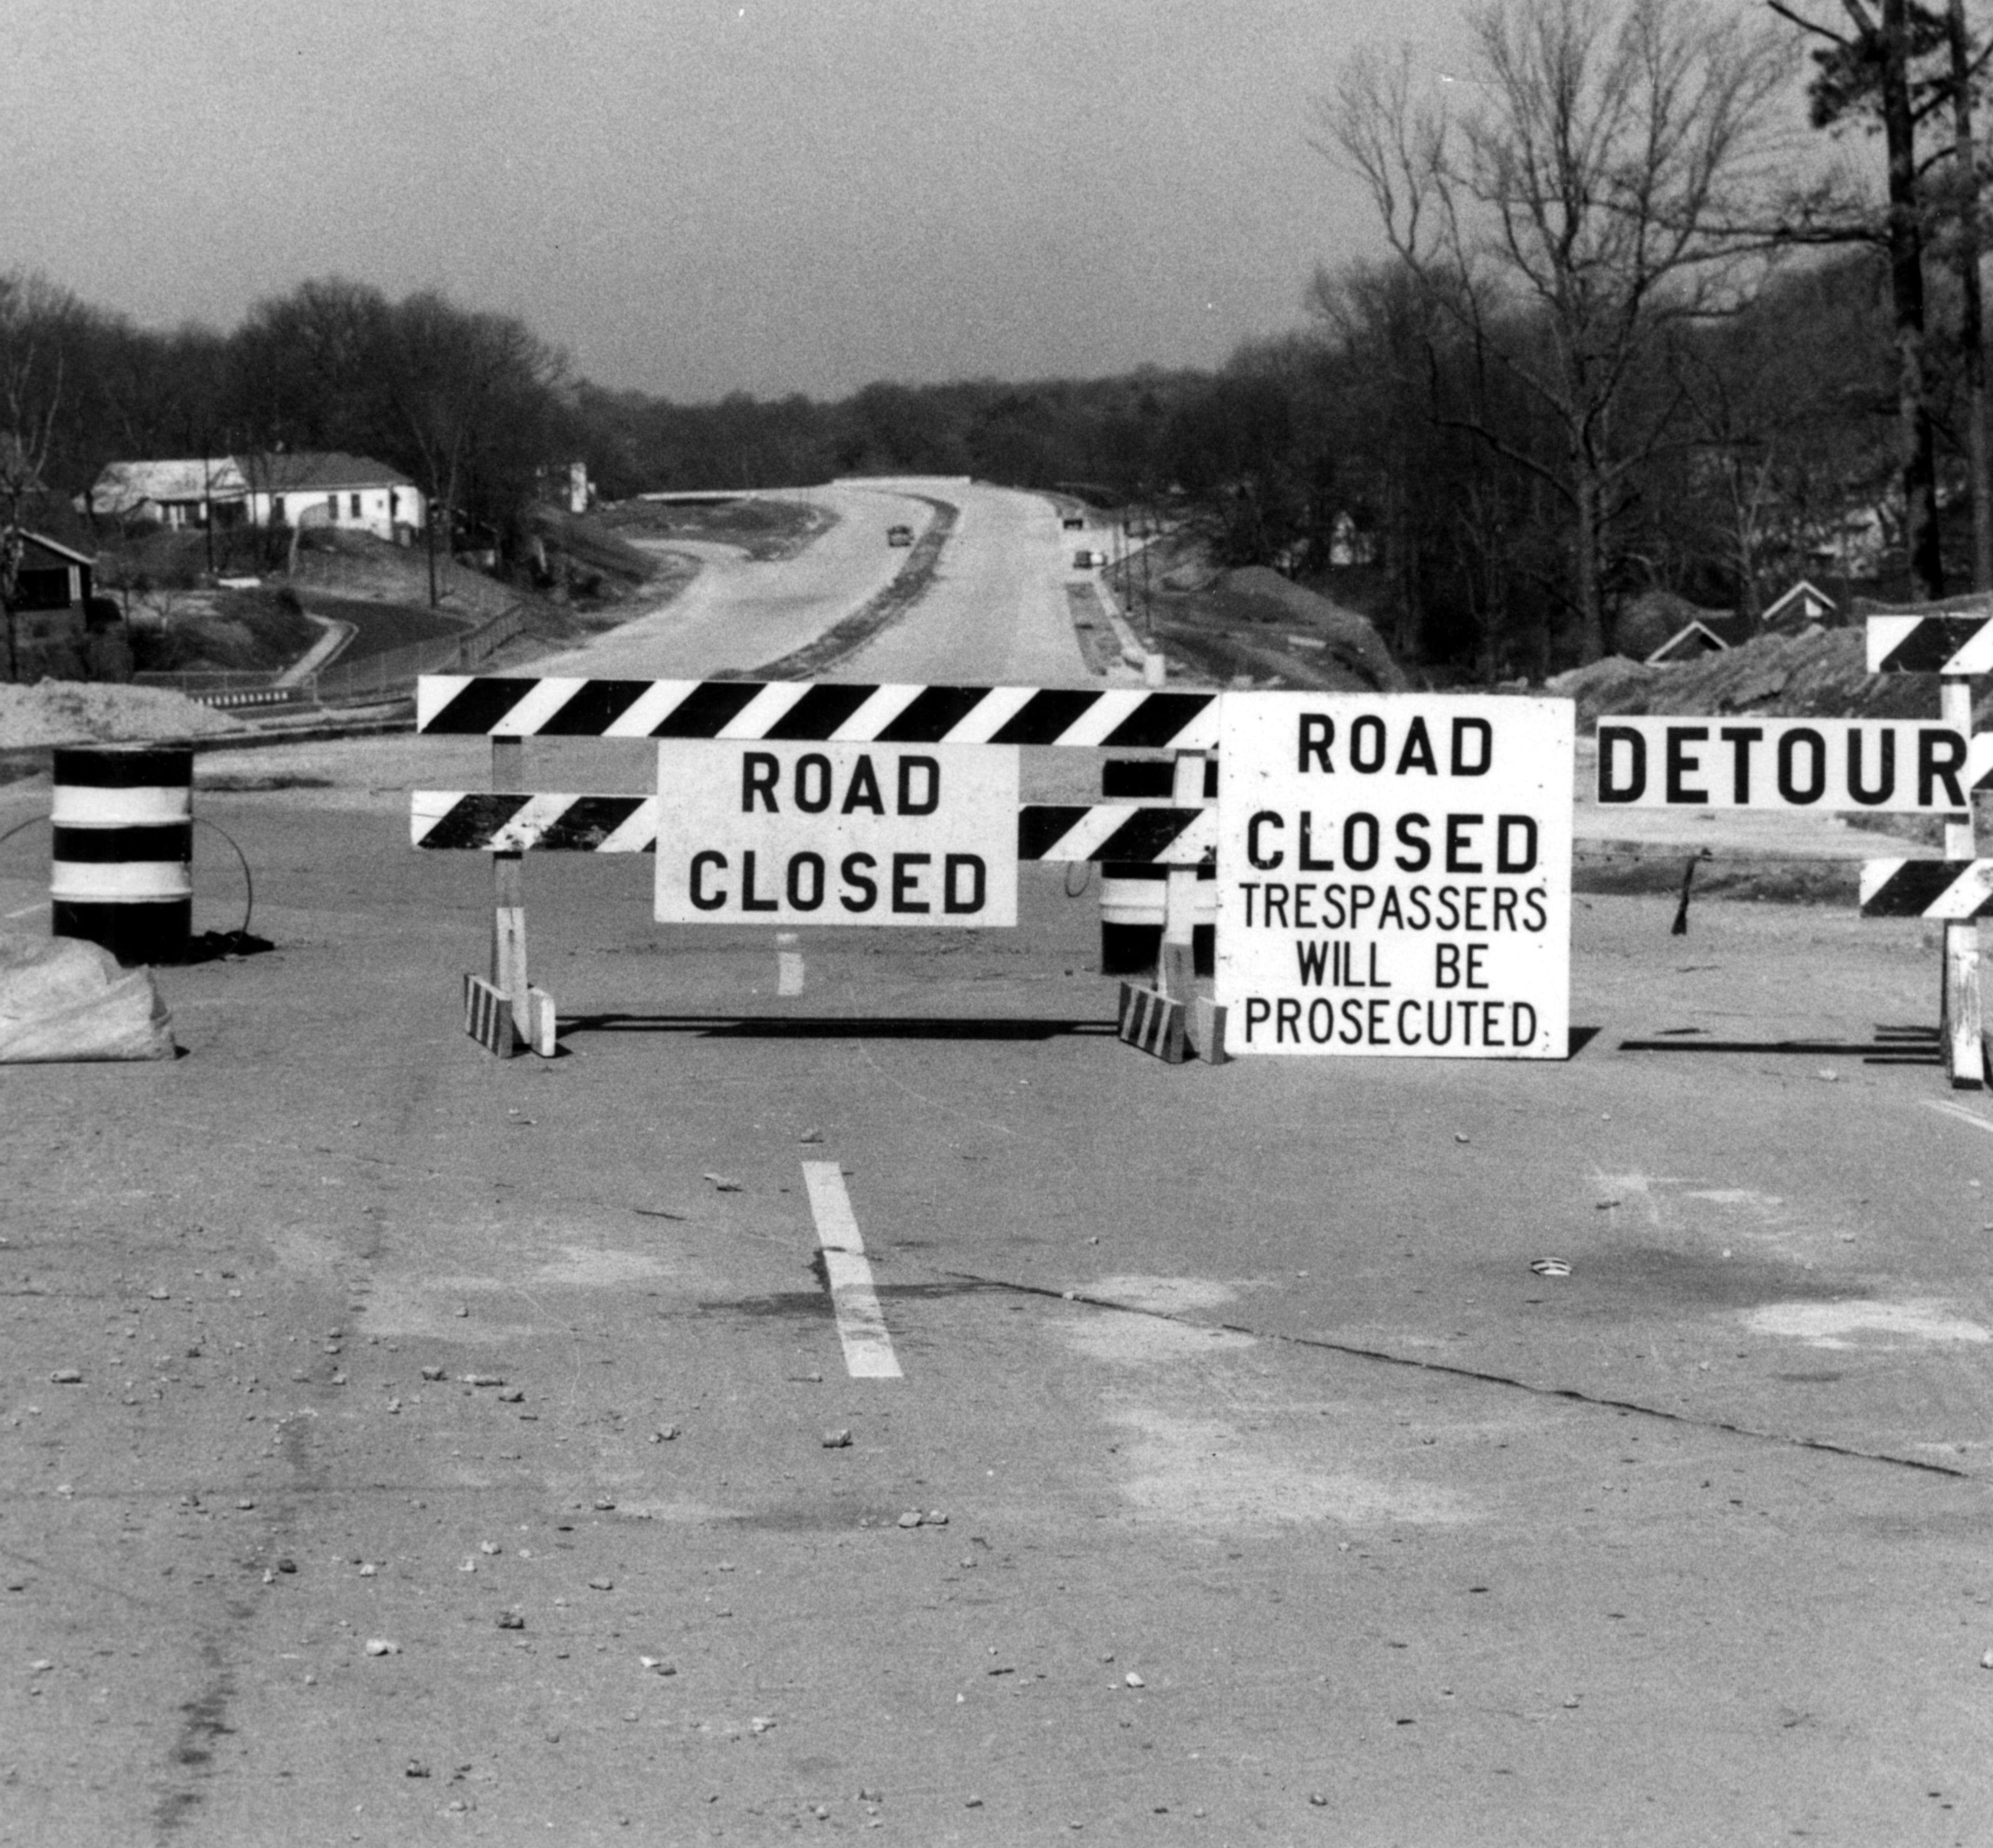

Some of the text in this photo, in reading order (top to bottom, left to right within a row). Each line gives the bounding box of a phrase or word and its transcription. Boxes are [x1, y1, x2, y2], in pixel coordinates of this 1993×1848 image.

[1299, 713, 1493, 776] ROAD
[1598, 726, 1968, 806] DETOUR
[742, 751, 940, 816] ROAD
[1247, 811, 1537, 874] CLOSED
[689, 850, 986, 914] CLOSED
[1239, 883, 1547, 932] TRESPASSERS
[1296, 941, 1489, 989] WILL BE
[1246, 997, 1536, 1047] PROSECUTED
